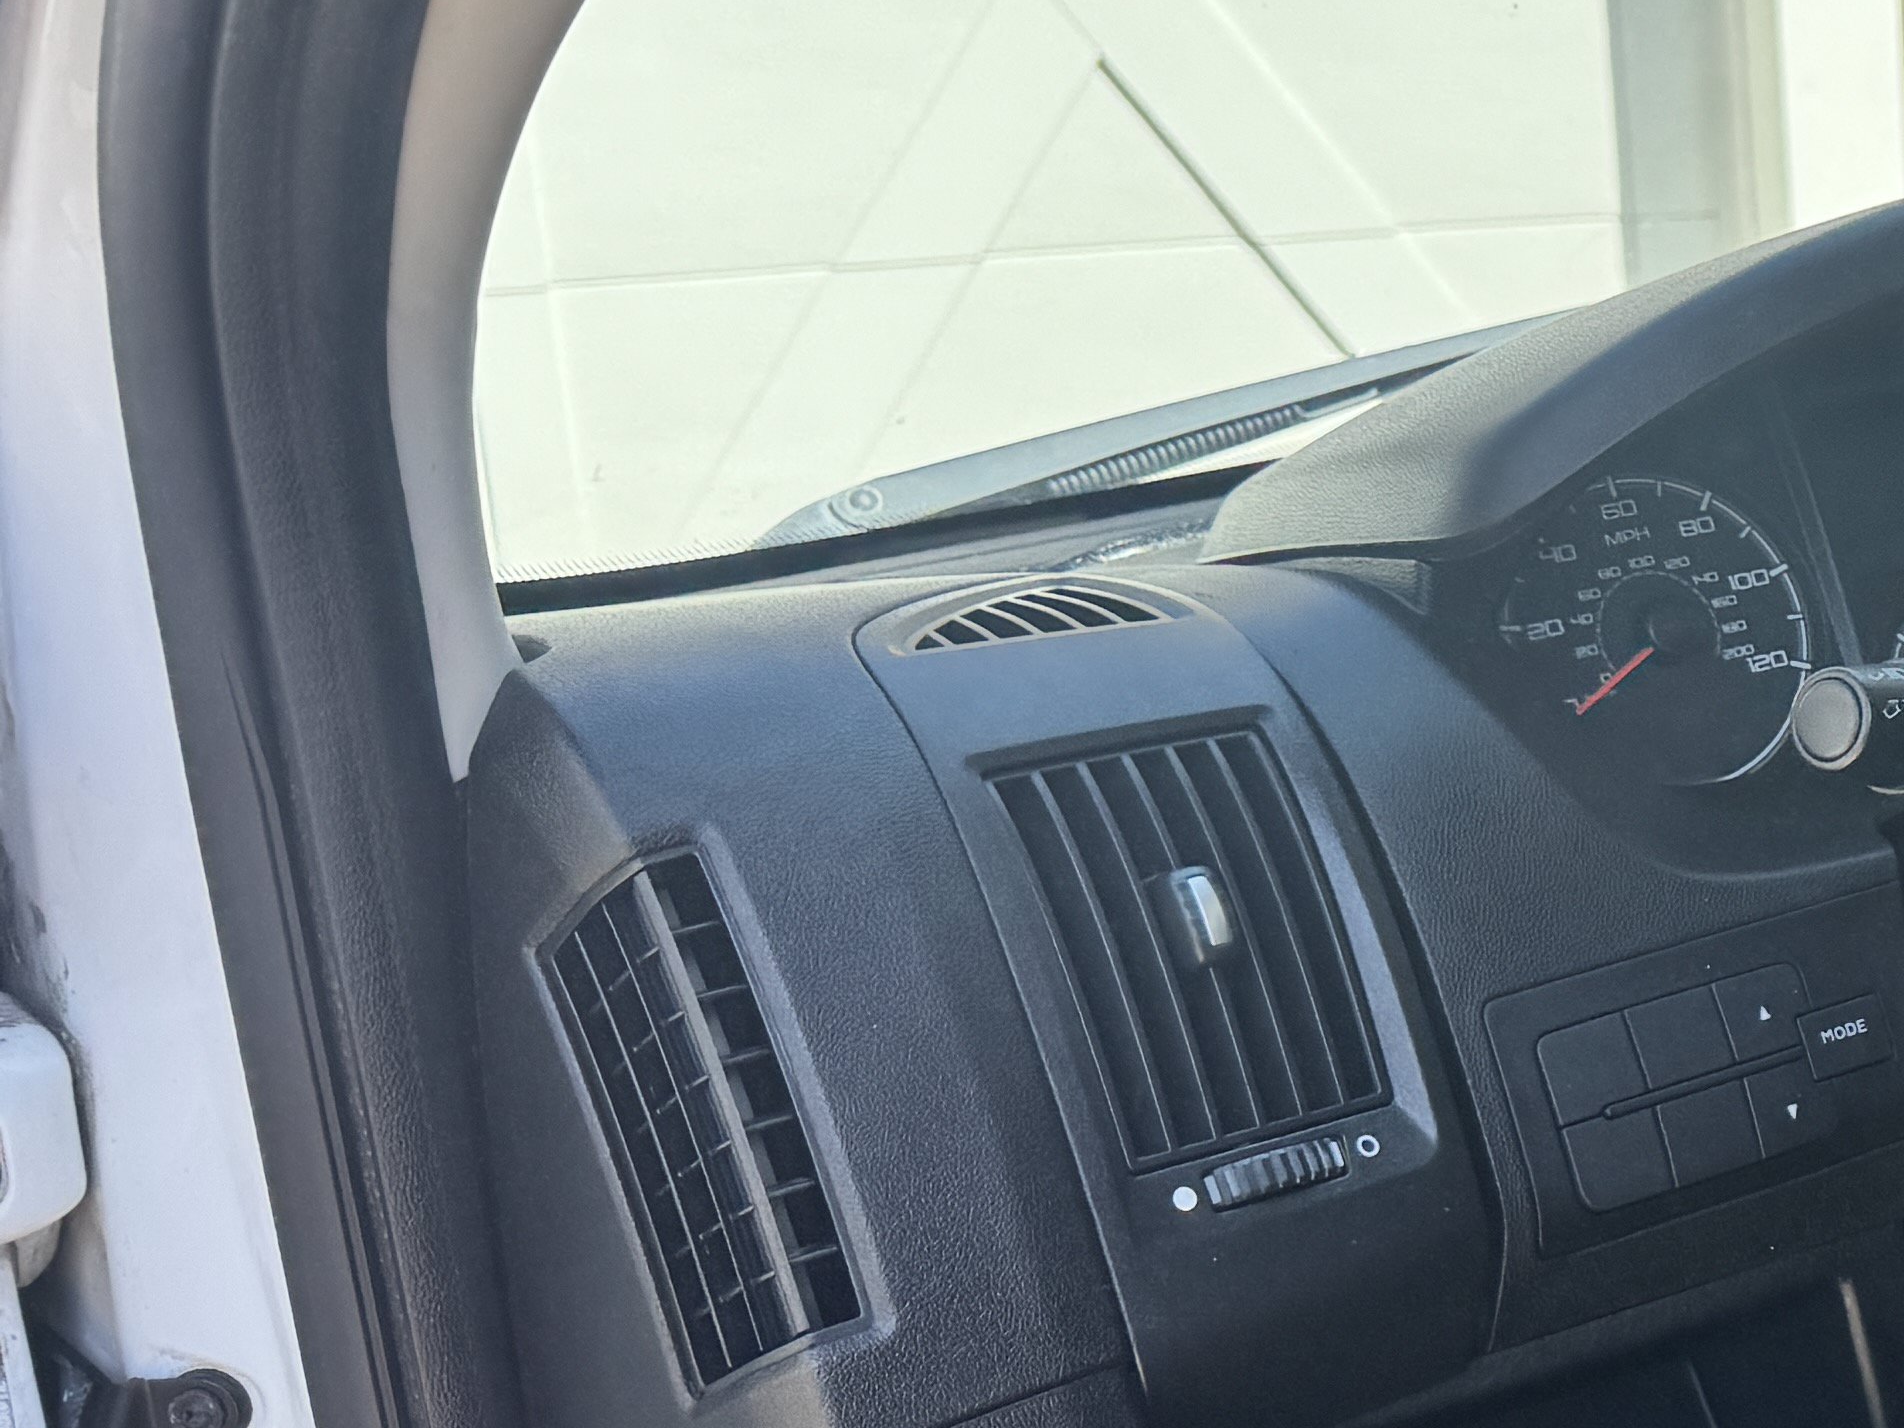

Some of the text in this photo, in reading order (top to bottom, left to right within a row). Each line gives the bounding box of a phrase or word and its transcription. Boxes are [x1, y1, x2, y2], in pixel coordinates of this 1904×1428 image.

[1600, 499, 1637, 520] 60
[1604, 526, 1650, 547] MPH
[1678, 516, 1716, 537] 80
[1539, 544, 1577, 563] 40
[1728, 568, 1770, 591] 100
[1526, 618, 1565, 641] 20
[1745, 649, 1789, 673] 120
[1820, 1018, 1868, 1044] MODE
